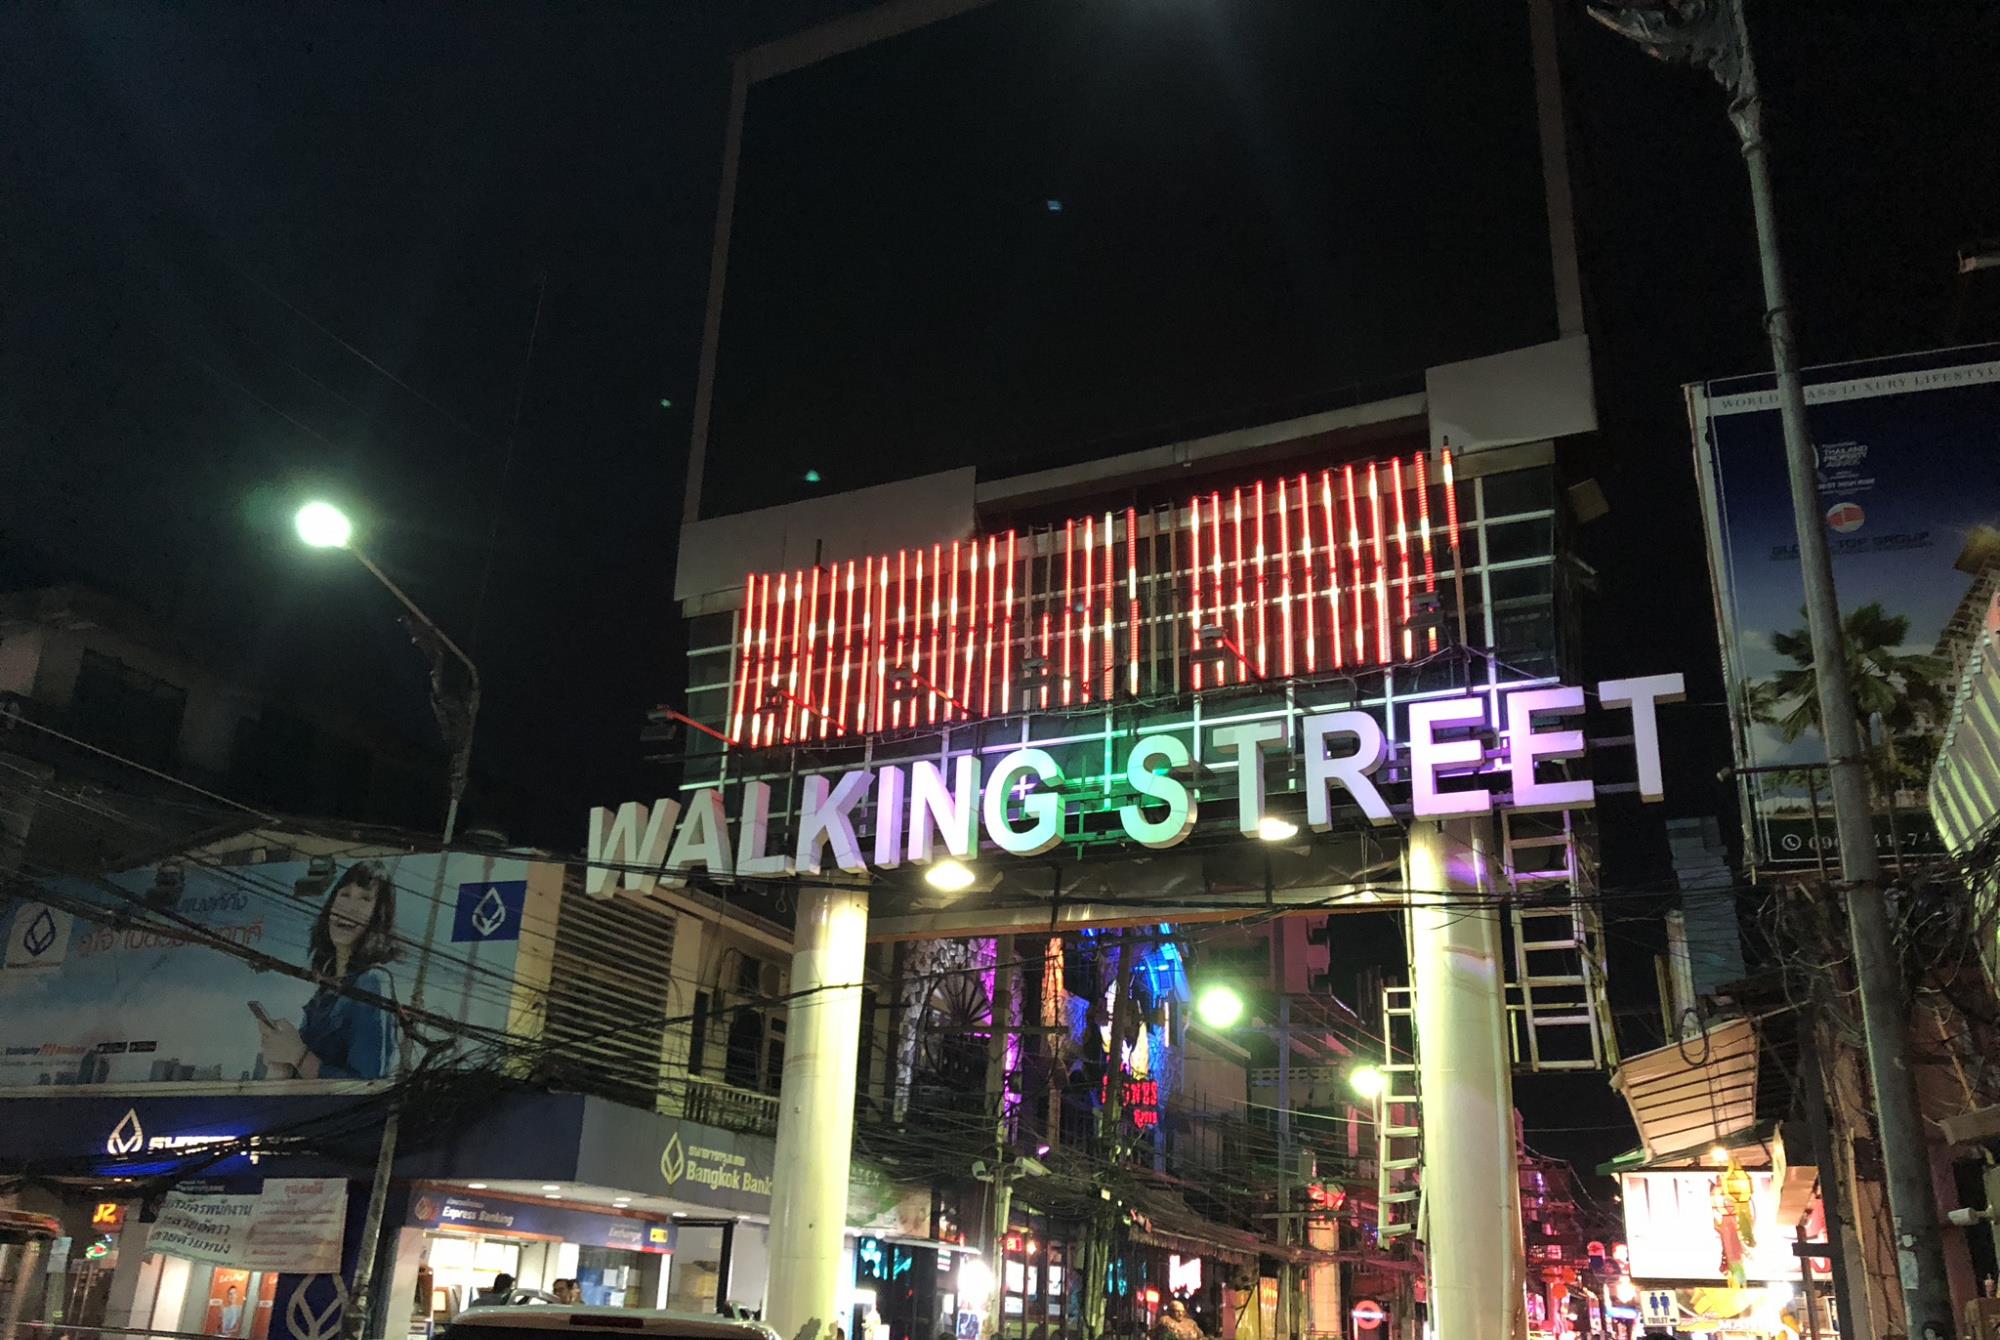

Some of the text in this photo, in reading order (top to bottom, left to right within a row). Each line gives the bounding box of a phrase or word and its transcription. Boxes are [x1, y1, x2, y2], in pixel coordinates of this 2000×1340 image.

[585, 672, 1686, 899] WALKING STREET
[686, 1160, 773, 1197] Bangkok Bank
[442, 1205, 515, 1228] Express Banking
[1647, 1317, 1669, 1325] TOILET
